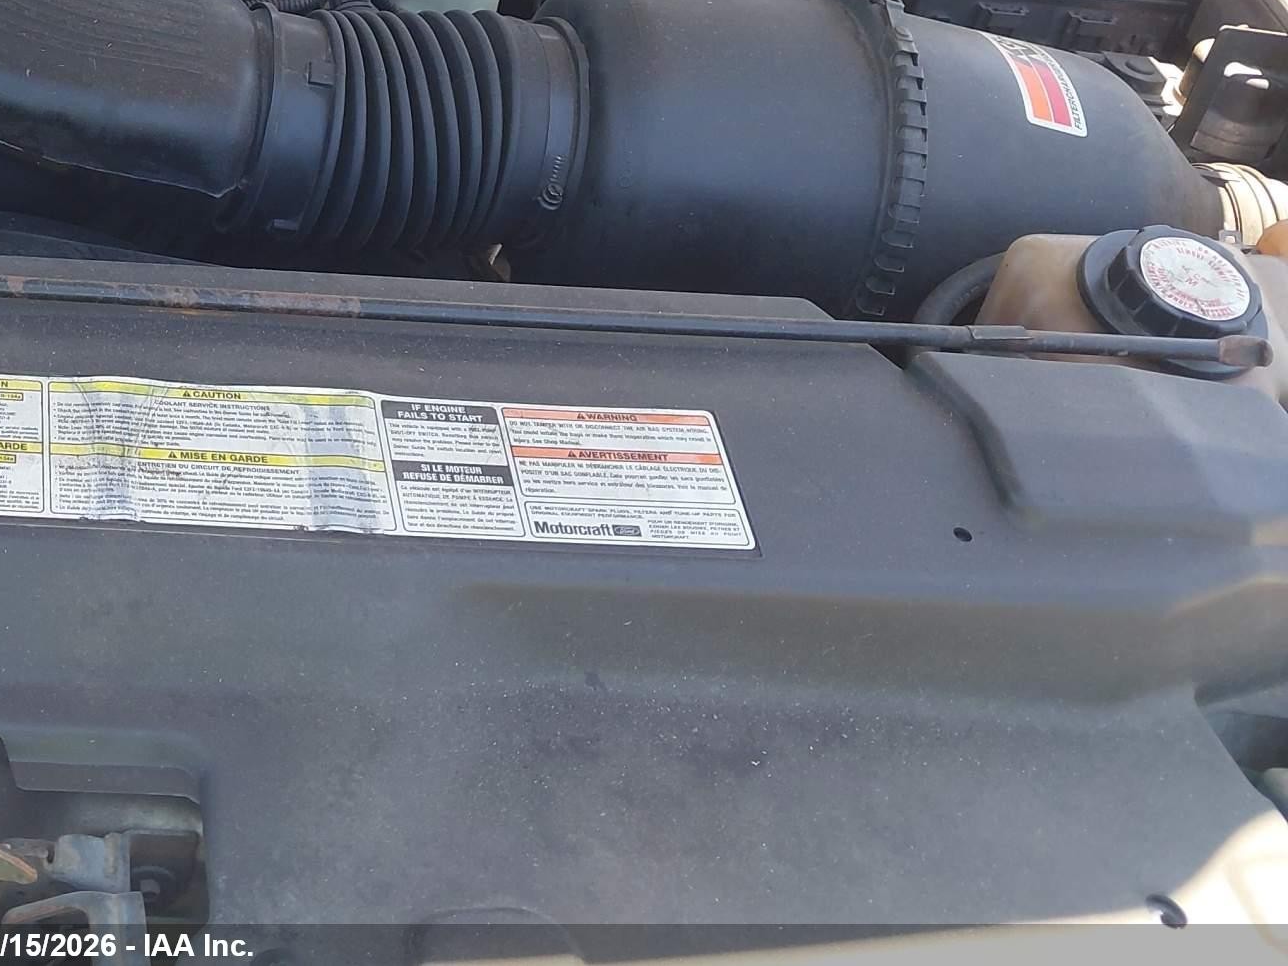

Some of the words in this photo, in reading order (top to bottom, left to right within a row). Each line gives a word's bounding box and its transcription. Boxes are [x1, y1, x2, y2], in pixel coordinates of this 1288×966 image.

[192, 391, 241, 401] CAUTION
[154, 399, 187, 407] COOLANT
[188, 401, 218, 409] SERVICE
[219, 403, 271, 412] INSTRUCTIONS
[410, 403, 422, 412] IF
[424, 404, 467, 415] ENGINE
[397, 411, 429, 421] FAILS
[430, 412, 446, 421] TO
[448, 413, 484, 424] START
[587, 412, 638, 422] WARNING
[179, 451, 208, 461] MISE
[211, 452, 227, 462] EN
[229, 454, 270, 464] GARDE
[578, 451, 669, 463] AVERTISSEMENT
[137, 461, 177, 469] ENTRETIEN
[178, 462, 189, 470] DU
[190, 463, 220, 472] CIRCUIT
[420, 463, 431, 472] SI
[432, 464, 444, 473] LE
[445, 464, 483, 475] MOTEUR
[402, 471, 438, 482] REFUSE
[439, 472, 452, 483] DE
[533, 520, 613, 537] Motorcraft
